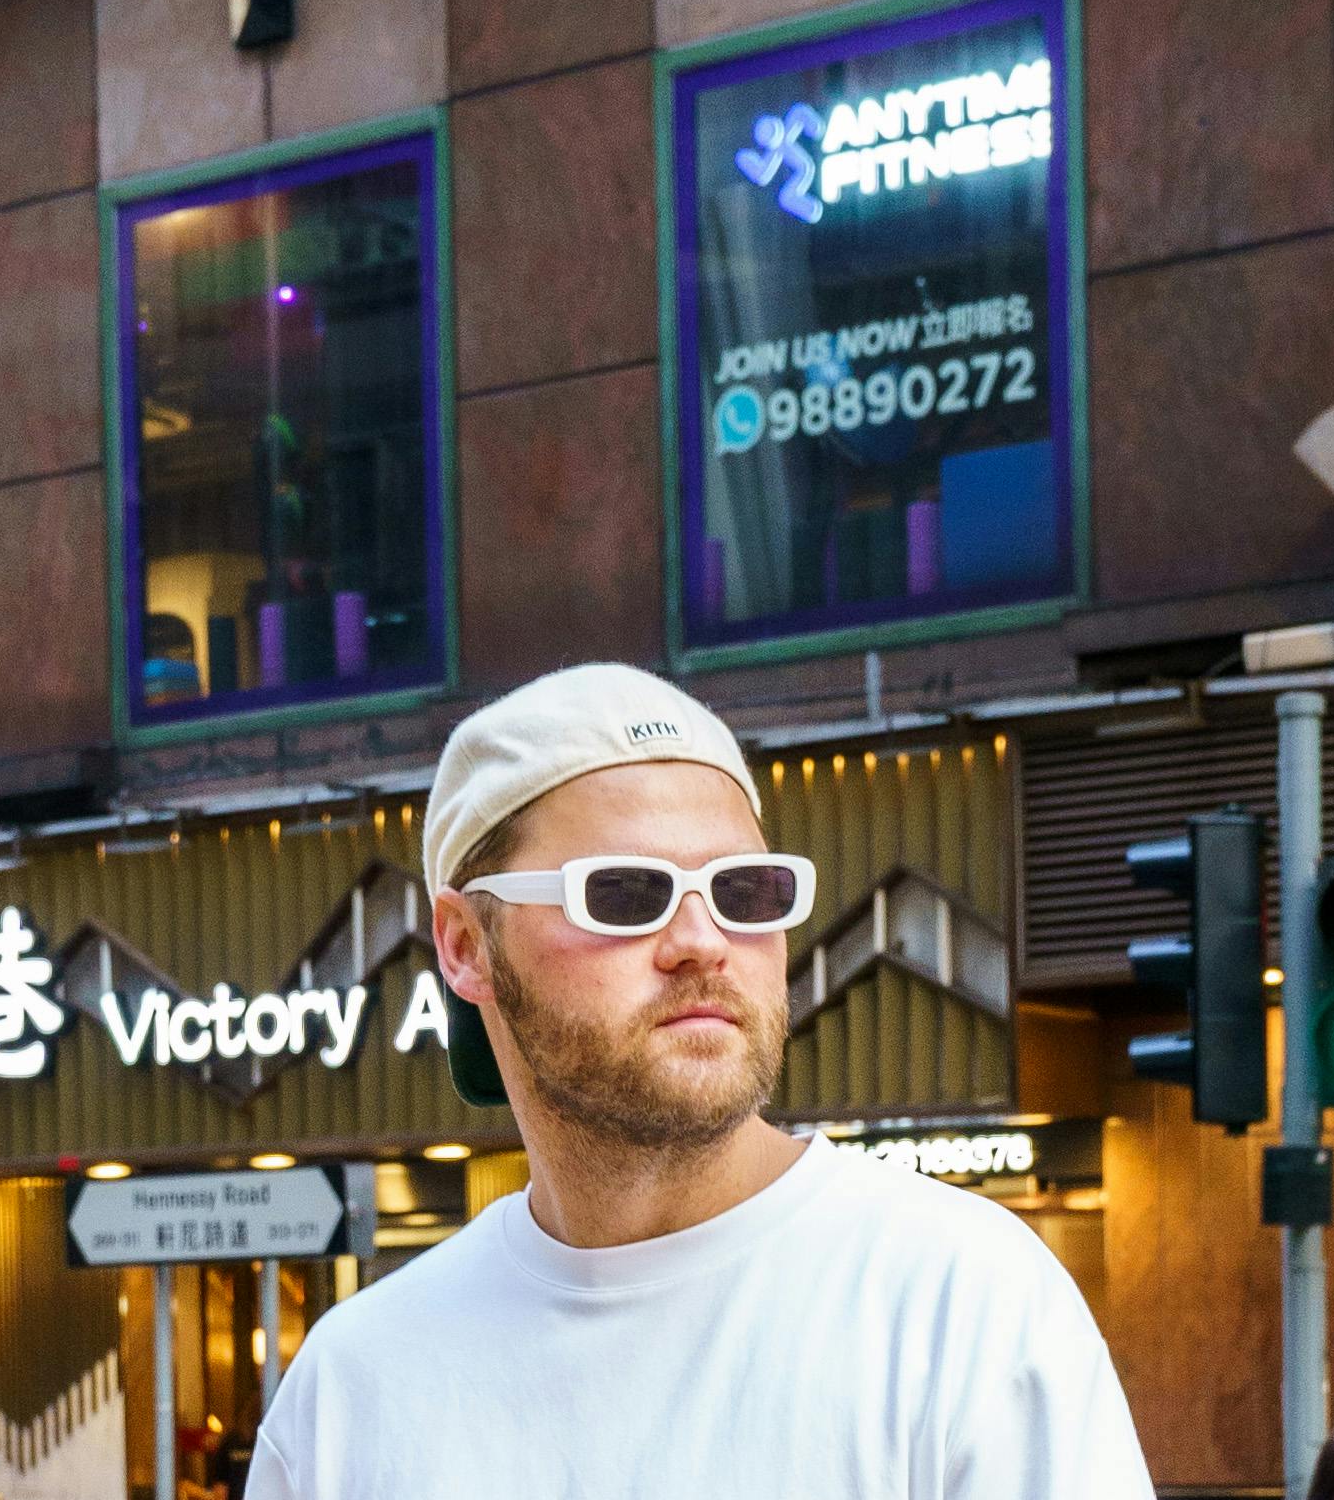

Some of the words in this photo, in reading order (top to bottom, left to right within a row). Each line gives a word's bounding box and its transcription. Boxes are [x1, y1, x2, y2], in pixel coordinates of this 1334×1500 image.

[713, 340, 788, 384] JOIN
[791, 332, 835, 369] US
[836, 314, 919, 363] NOW
[767, 346, 1037, 442] 98890272
[630, 722, 679, 739] KITH
[99, 981, 367, 1069] Victory
[132, 1187, 216, 1212] Hennessy
[222, 1181, 271, 1205] Road
[155, 1218, 250, 1250] 軒尼詩道
